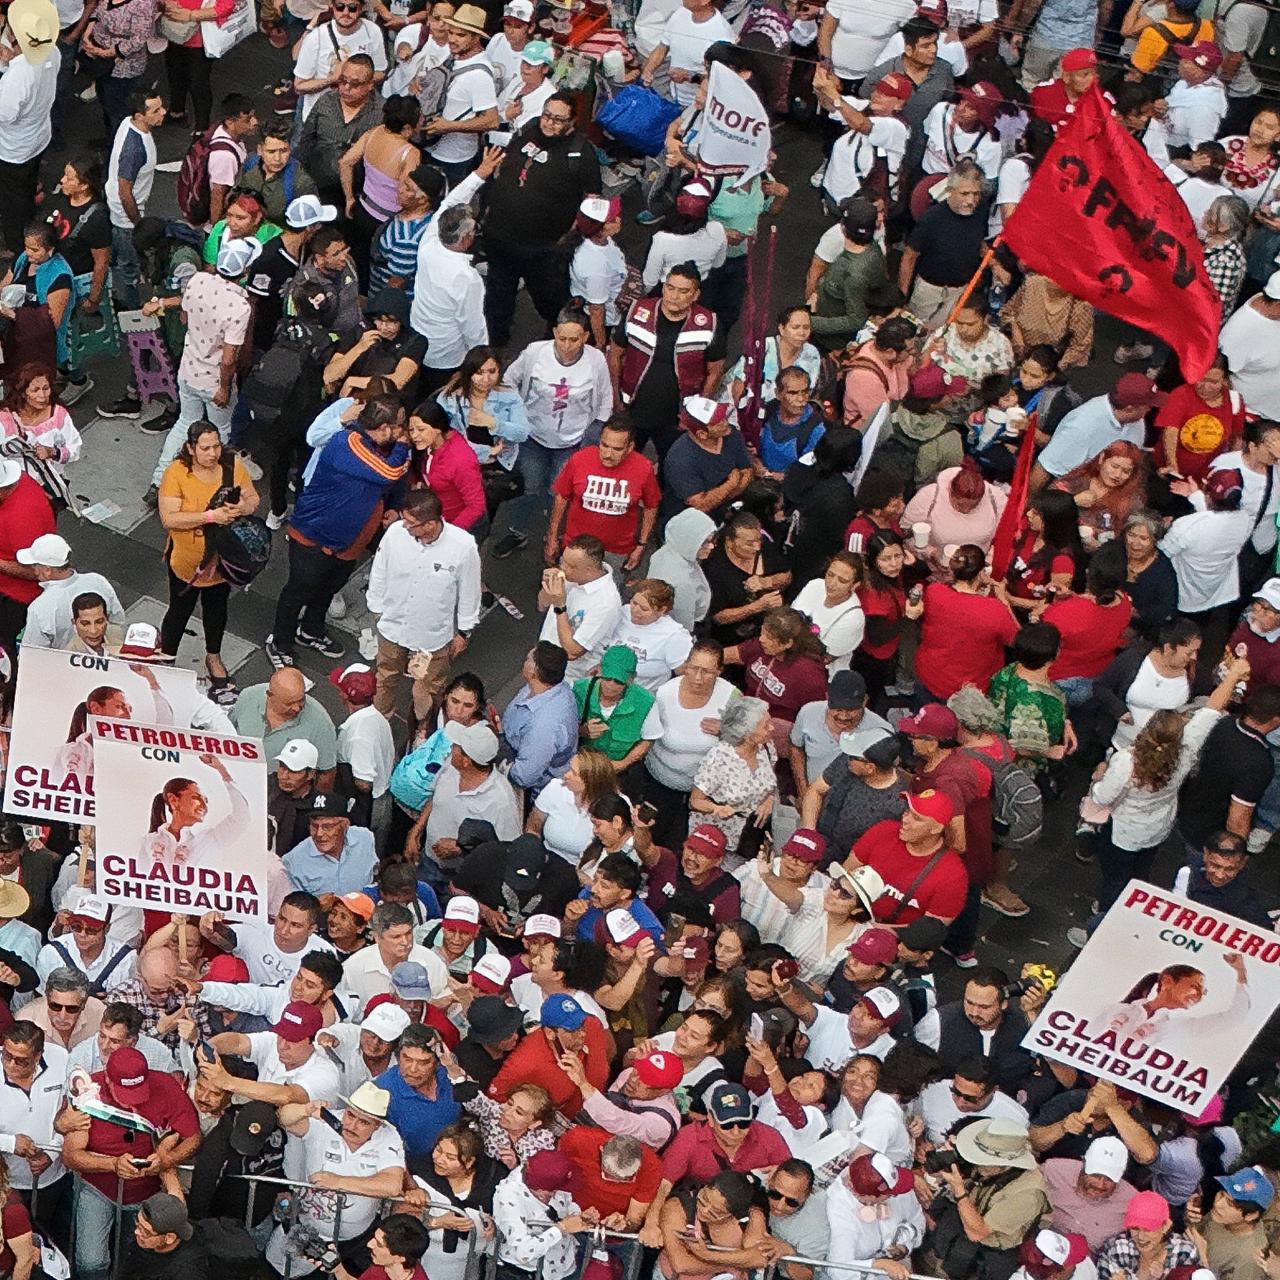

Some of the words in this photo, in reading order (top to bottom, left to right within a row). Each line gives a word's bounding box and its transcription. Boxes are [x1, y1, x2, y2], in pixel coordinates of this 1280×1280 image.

[583, 474, 630, 501] HILL
[69, 653, 110, 673] CON
[95, 721, 259, 761] PETROLEROS
[141, 747, 180, 764] CON
[102, 854, 259, 896] CLAUDIA
[104, 879, 259, 917] SHEIBAUM
[1124, 888, 1280, 968] PETROLERO
[1159, 928, 1204, 954] CON
[1035, 1030, 1202, 1106] SHEIBAUM
[1047, 1009, 1209, 1089] CLAUDIA
